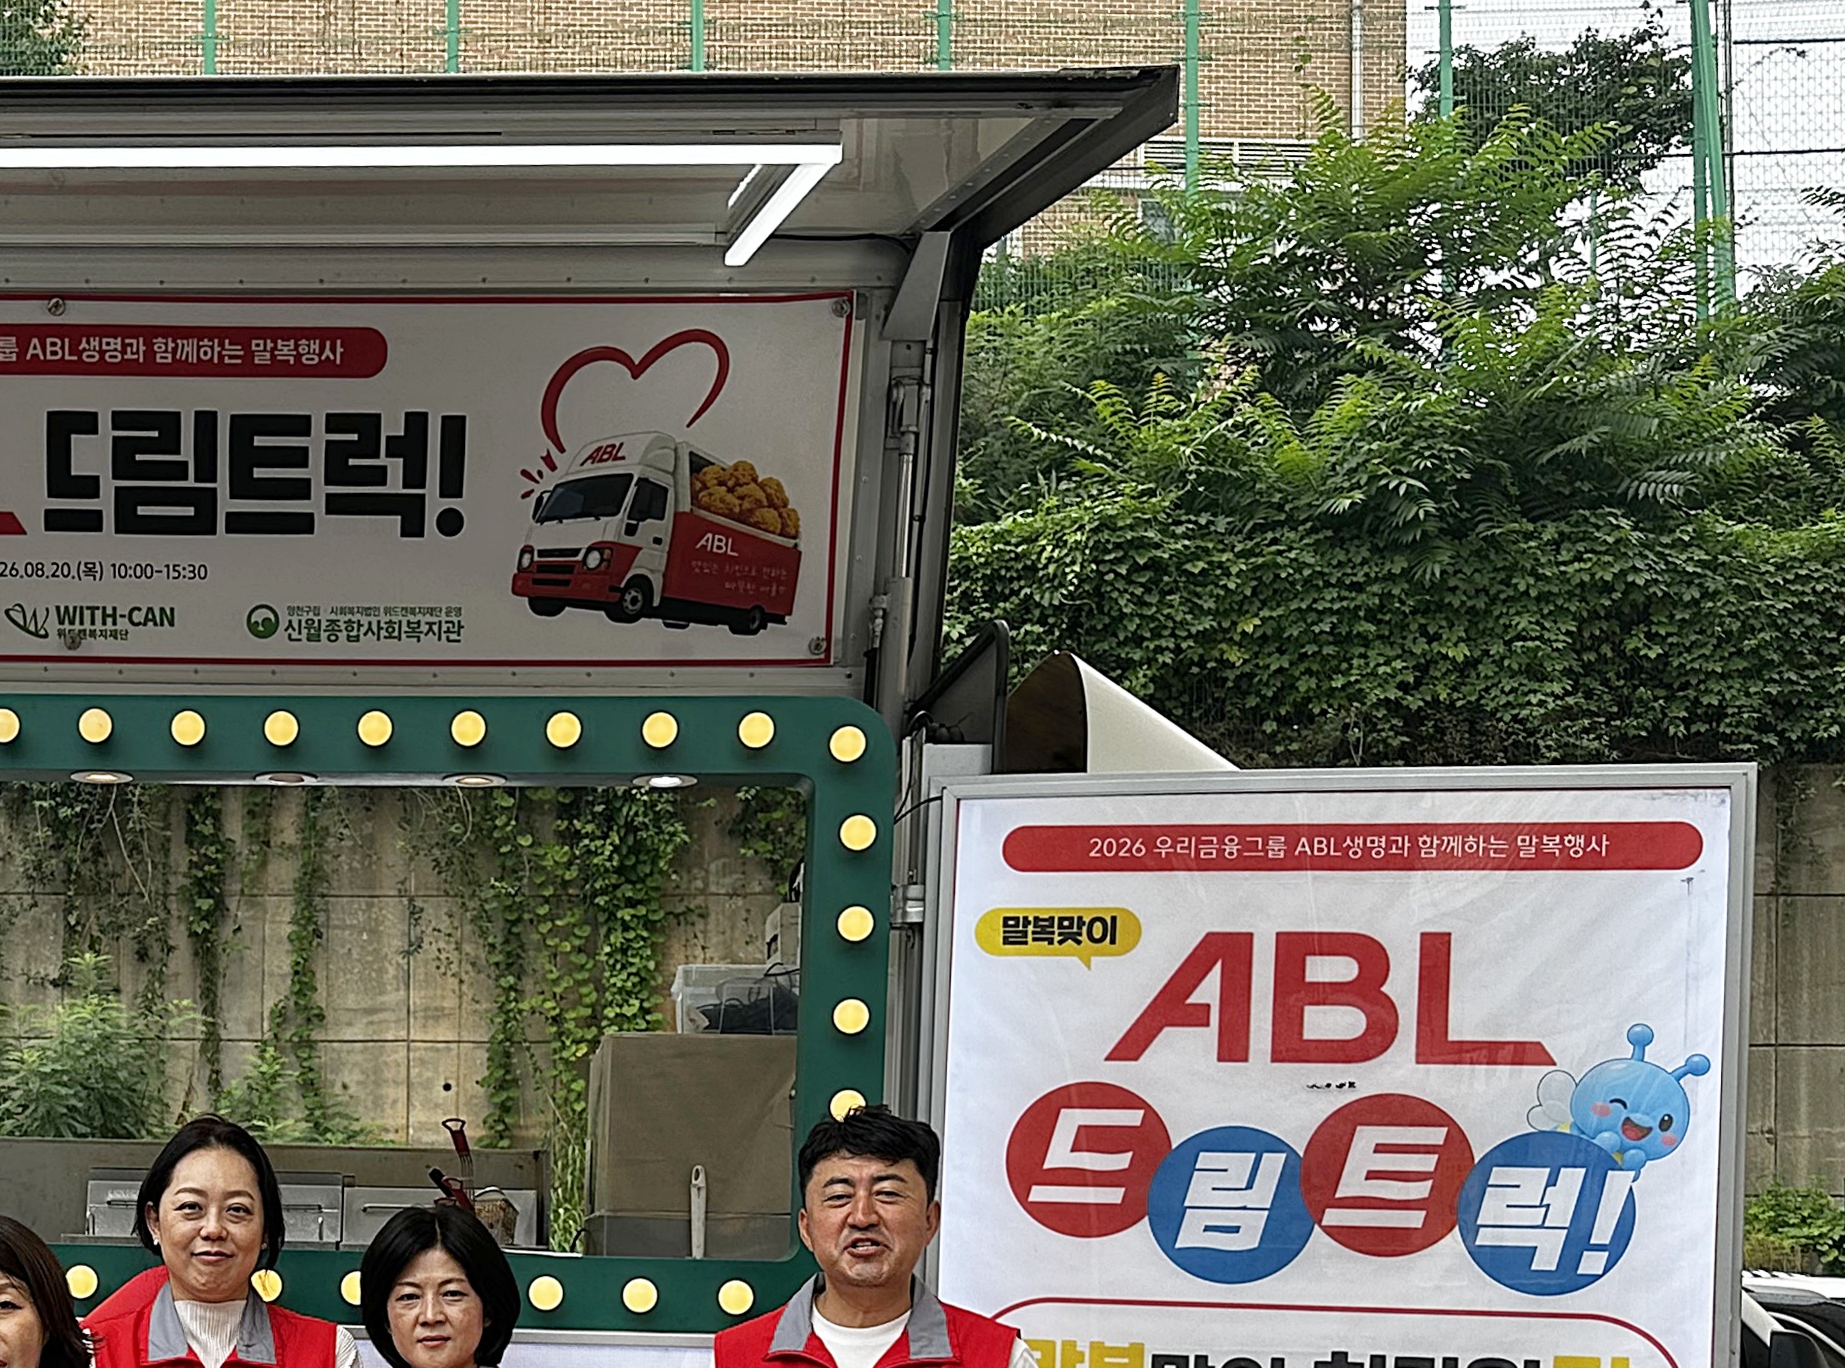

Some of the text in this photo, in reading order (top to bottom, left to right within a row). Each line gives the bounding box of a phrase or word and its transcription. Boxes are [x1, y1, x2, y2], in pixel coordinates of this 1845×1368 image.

[26, 336, 146, 364] ABL생명과
[153, 337, 244, 365] 함께하는
[251, 338, 344, 366] 말복행사
[580, 442, 626, 466] ABL
[44, 409, 468, 539] 드림트럭!
[696, 533, 739, 557] ABL
[55, 604, 176, 629] WITH-CAN
[283, 617, 465, 643] 신월종합사회복지관
[1088, 831, 1610, 861] 2026 우리금융그룹 ABL생명과 함께하는 말복행사
[1001, 915, 1119, 947] 말복맞이
[1104, 930, 1558, 1067] ABL
[1028, 1108, 1636, 1277] 드림트럭!
